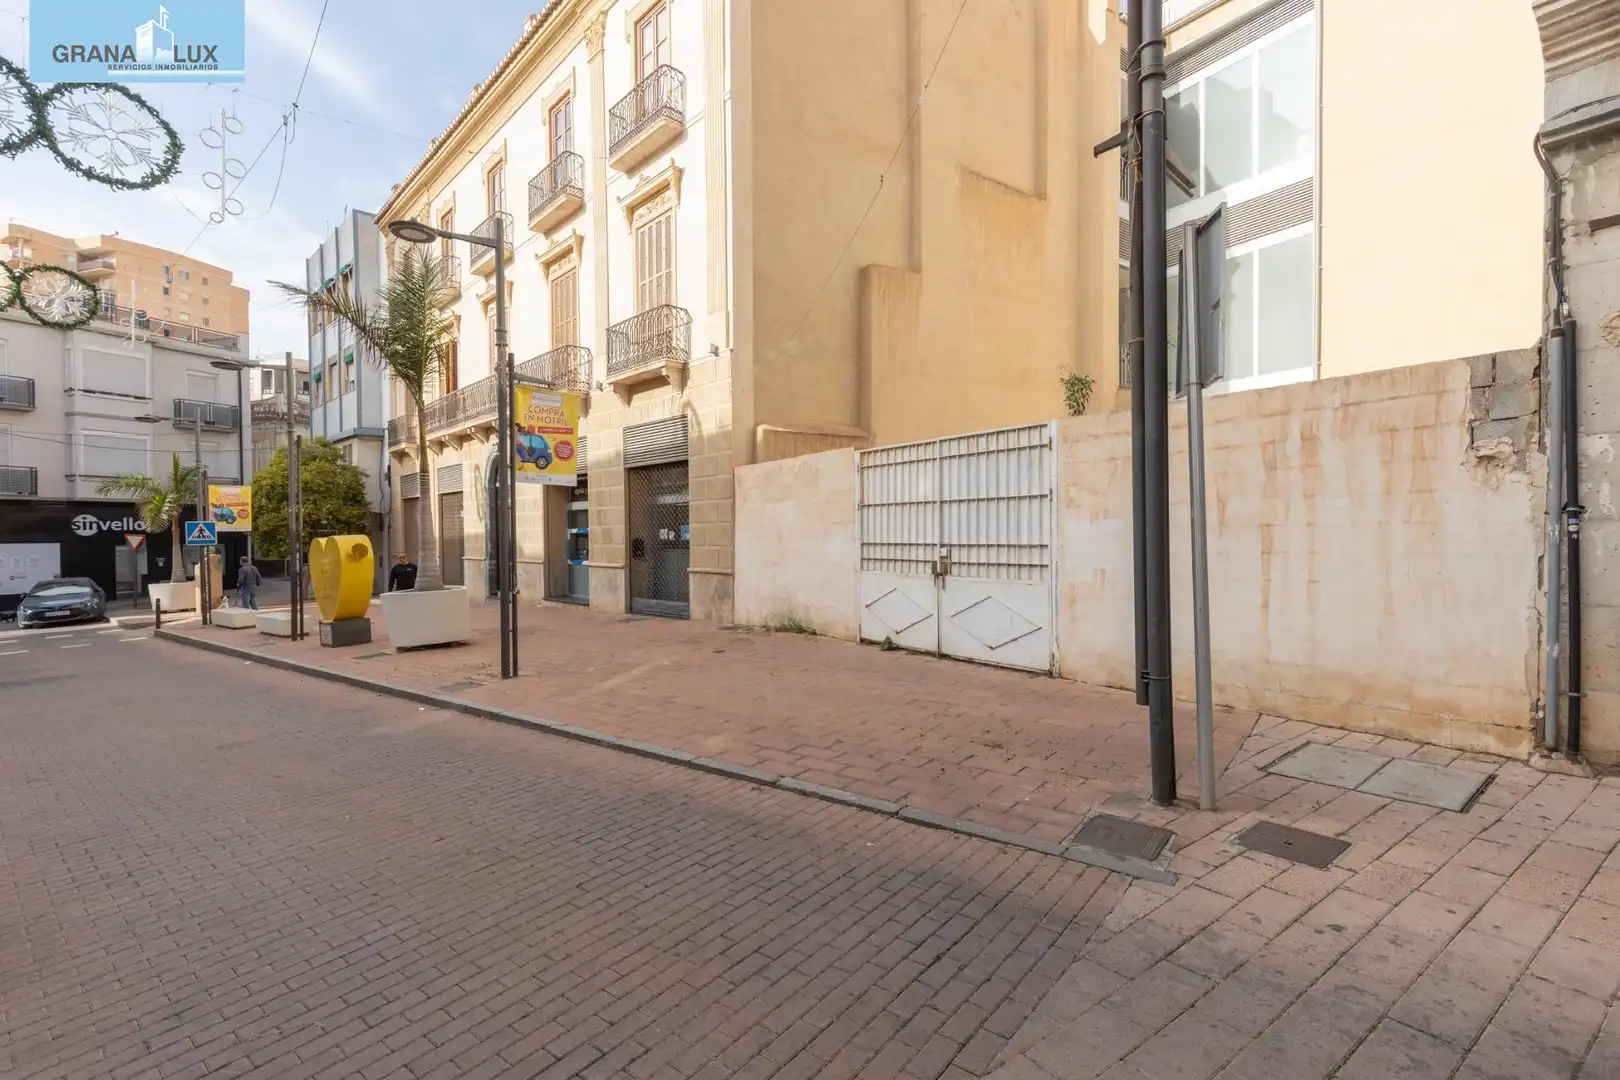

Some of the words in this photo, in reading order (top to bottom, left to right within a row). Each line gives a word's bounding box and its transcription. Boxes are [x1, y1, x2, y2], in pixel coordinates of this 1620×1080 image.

[527, 404, 565, 418] COMPRA
[523, 413, 535, 421] EN
[536, 415, 568, 427] MOTRIL
